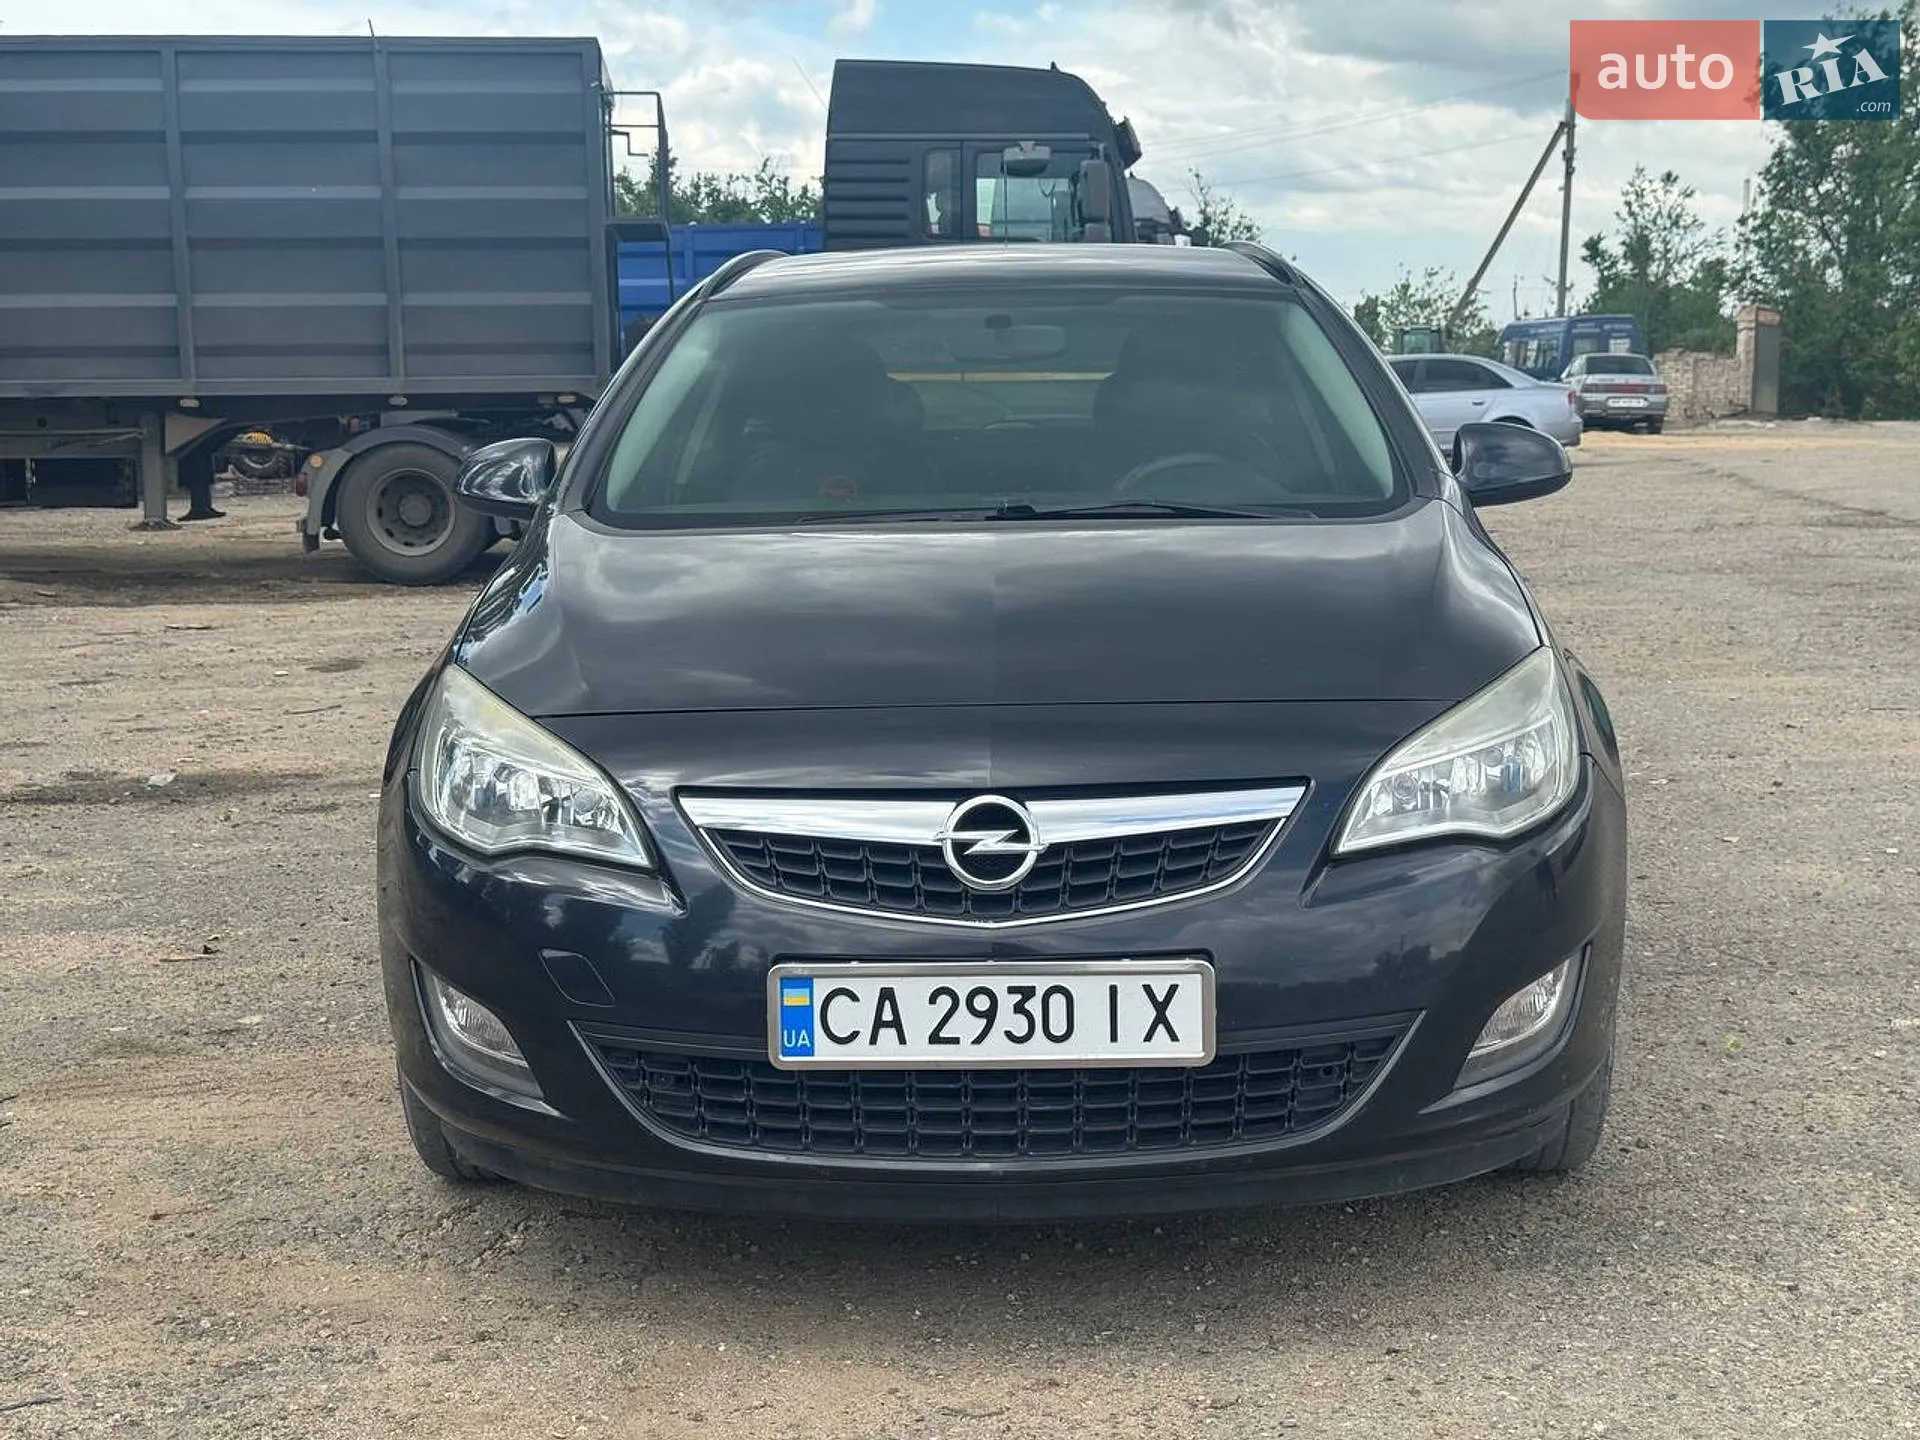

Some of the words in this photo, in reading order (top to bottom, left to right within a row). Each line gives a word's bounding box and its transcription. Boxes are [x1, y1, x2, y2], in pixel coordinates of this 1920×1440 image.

[819, 987, 907, 1046] CA
[927, 985, 1075, 1045] 2930
[783, 1031, 811, 1048] UA
